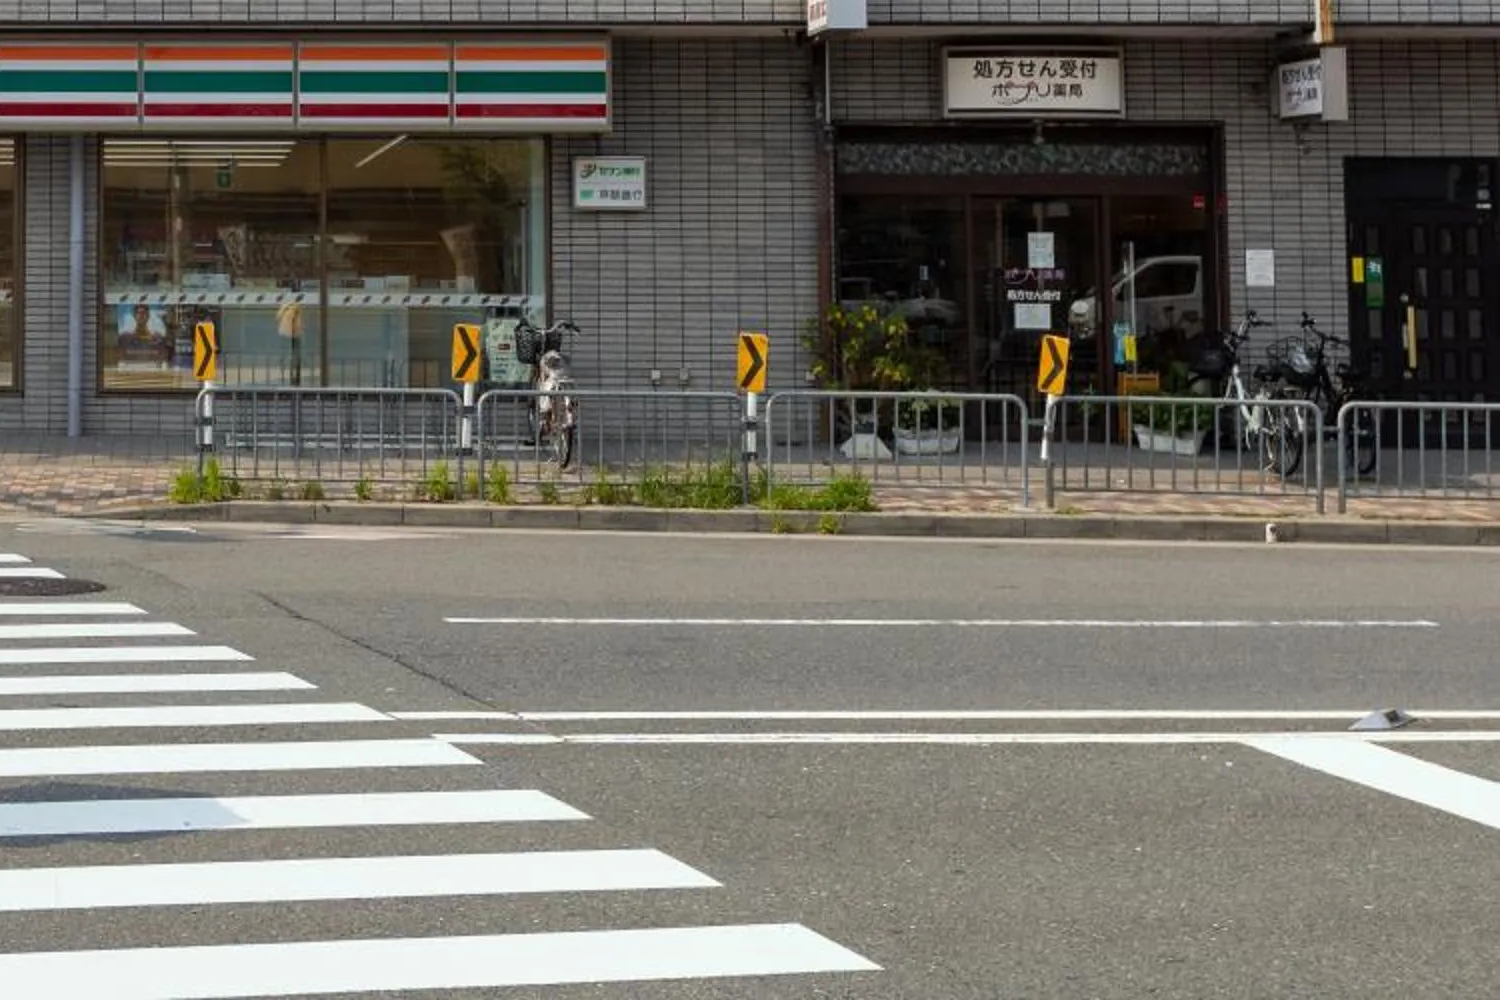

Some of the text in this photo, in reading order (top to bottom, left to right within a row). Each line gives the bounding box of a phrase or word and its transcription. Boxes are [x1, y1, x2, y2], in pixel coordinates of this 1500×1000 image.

[973, 59, 1097, 79] 処方せん受付
